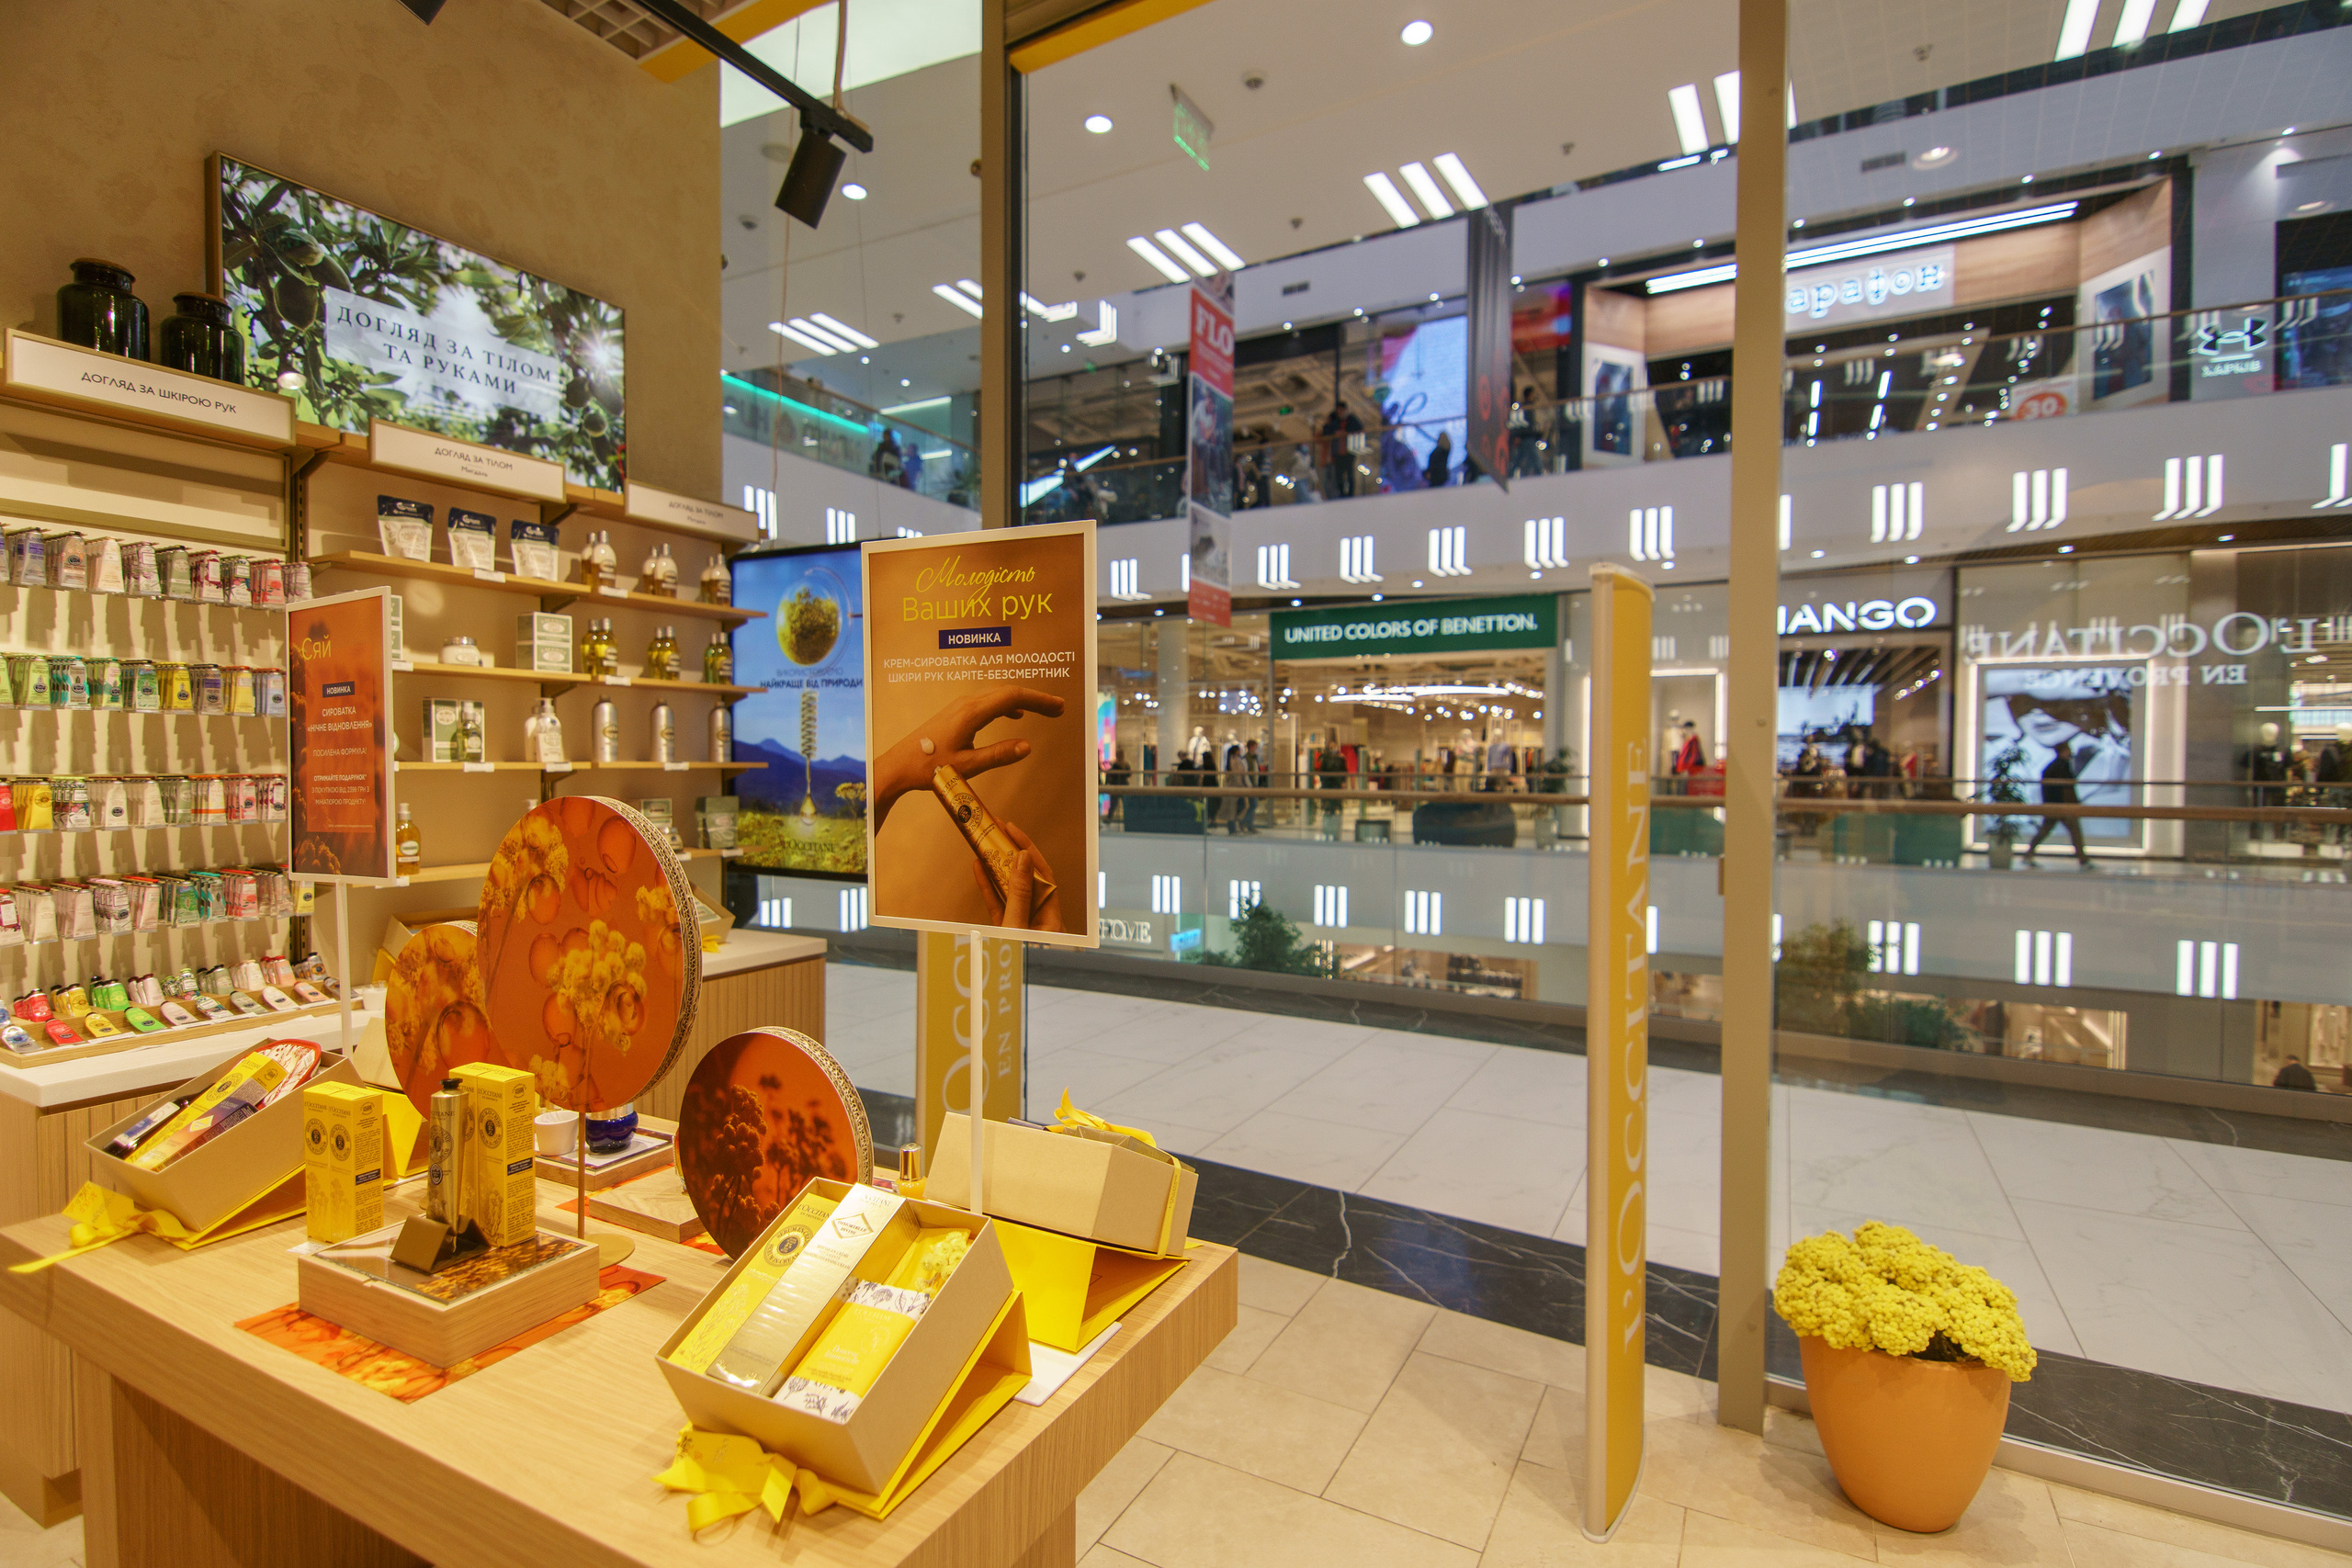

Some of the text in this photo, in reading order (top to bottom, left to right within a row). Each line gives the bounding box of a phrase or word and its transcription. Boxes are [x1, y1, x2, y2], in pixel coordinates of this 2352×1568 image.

[1785, 263, 1945, 316] арафон
[1196, 302, 1234, 356] FLO
[337, 306, 551, 383] ДОГЛЯД ЗА ТІЛОМ
[383, 343, 516, 394] ТА РУКАМИ
[81, 371, 237, 413] ДОГЛЯД ЗА ШКІРОЮ РУК
[435, 446, 513, 470] ДОГЛЯД ЗА ТІЛОМ
[915, 555, 1036, 606] Молодість
[902, 592, 1054, 622] Ваших рук
[948, 632, 1001, 645] НОВИНКА
[1284, 625, 1343, 643] UNITED
[1344, 620, 1411, 640] COLORS
[1412, 618, 1438, 637] OF
[884, 651, 1076, 669] КРЕМ-СИРОВАТКА ДЛЯ МОЛОДОСТІ
[760, 678, 863, 689] НАЙКРАЩЕ ВІД ПРИРОДИ
[888, 667, 1070, 682] ШКІРИ РУК КАРІТЕ-БЕЗСМЕРТНИК
[326, 685, 351, 694] НОВИНКА
[322, 706, 356, 716] СИРОВАТКА
[797, 1203, 831, 1218] L'OCCITAN
